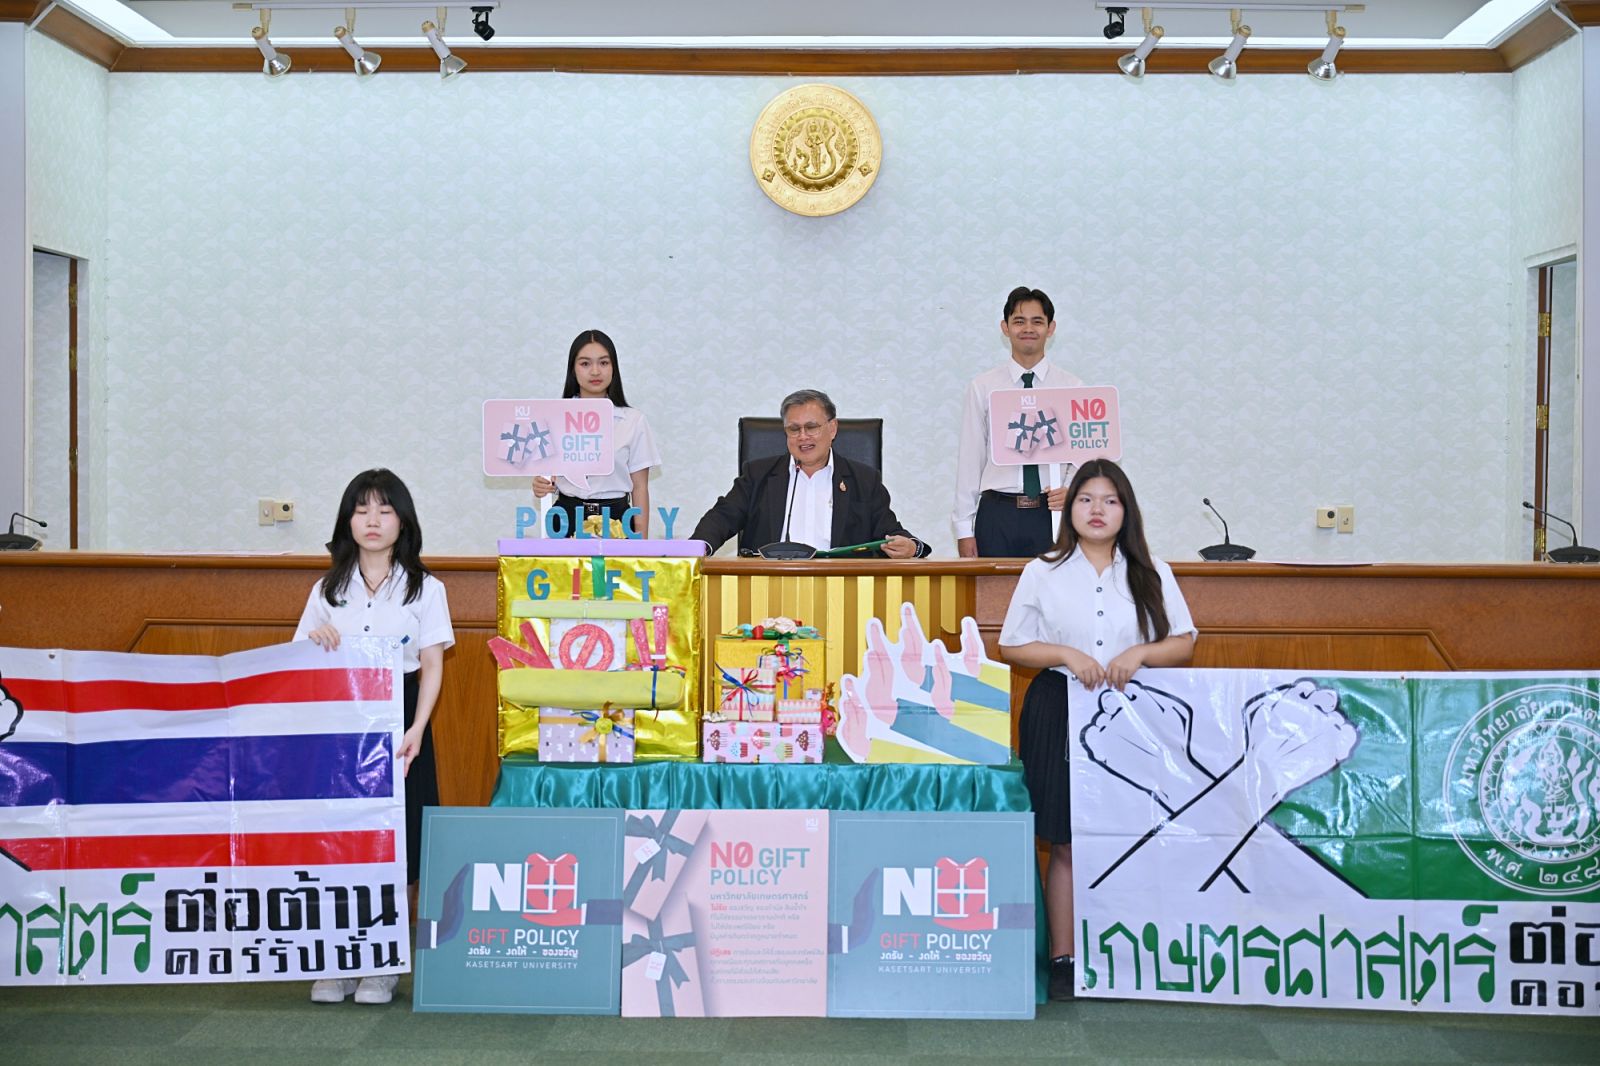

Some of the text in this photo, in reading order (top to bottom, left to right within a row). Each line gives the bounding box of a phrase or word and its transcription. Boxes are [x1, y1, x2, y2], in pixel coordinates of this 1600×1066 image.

[1020, 395, 1037, 405] KU
[514, 406, 531, 417] KU
[1069, 421, 1110, 439] GIFT
[562, 434, 603, 451] GIFT
[1071, 438, 1109, 449] POLICY
[563, 453, 602, 462] POLICY
[515, 506, 680, 540] POLICY
[758, 847, 811, 868] GIFT
[710, 869, 782, 886] POLICY
[165, 871, 399, 932] ต่อต้าน
[468, 928, 580, 946] GIFT POLICY
[880, 932, 992, 950] GIFT POLICY
[165, 930, 401, 975] คอร์รัปชั่น
[1082, 904, 1499, 1003] เกษตรศาสตร์
[466, 961, 578, 970] KASETSART UNIVERSITY
[878, 965, 992, 974] KASETSART UNIVERSITY
[1511, 979, 1600, 1008] คอ
